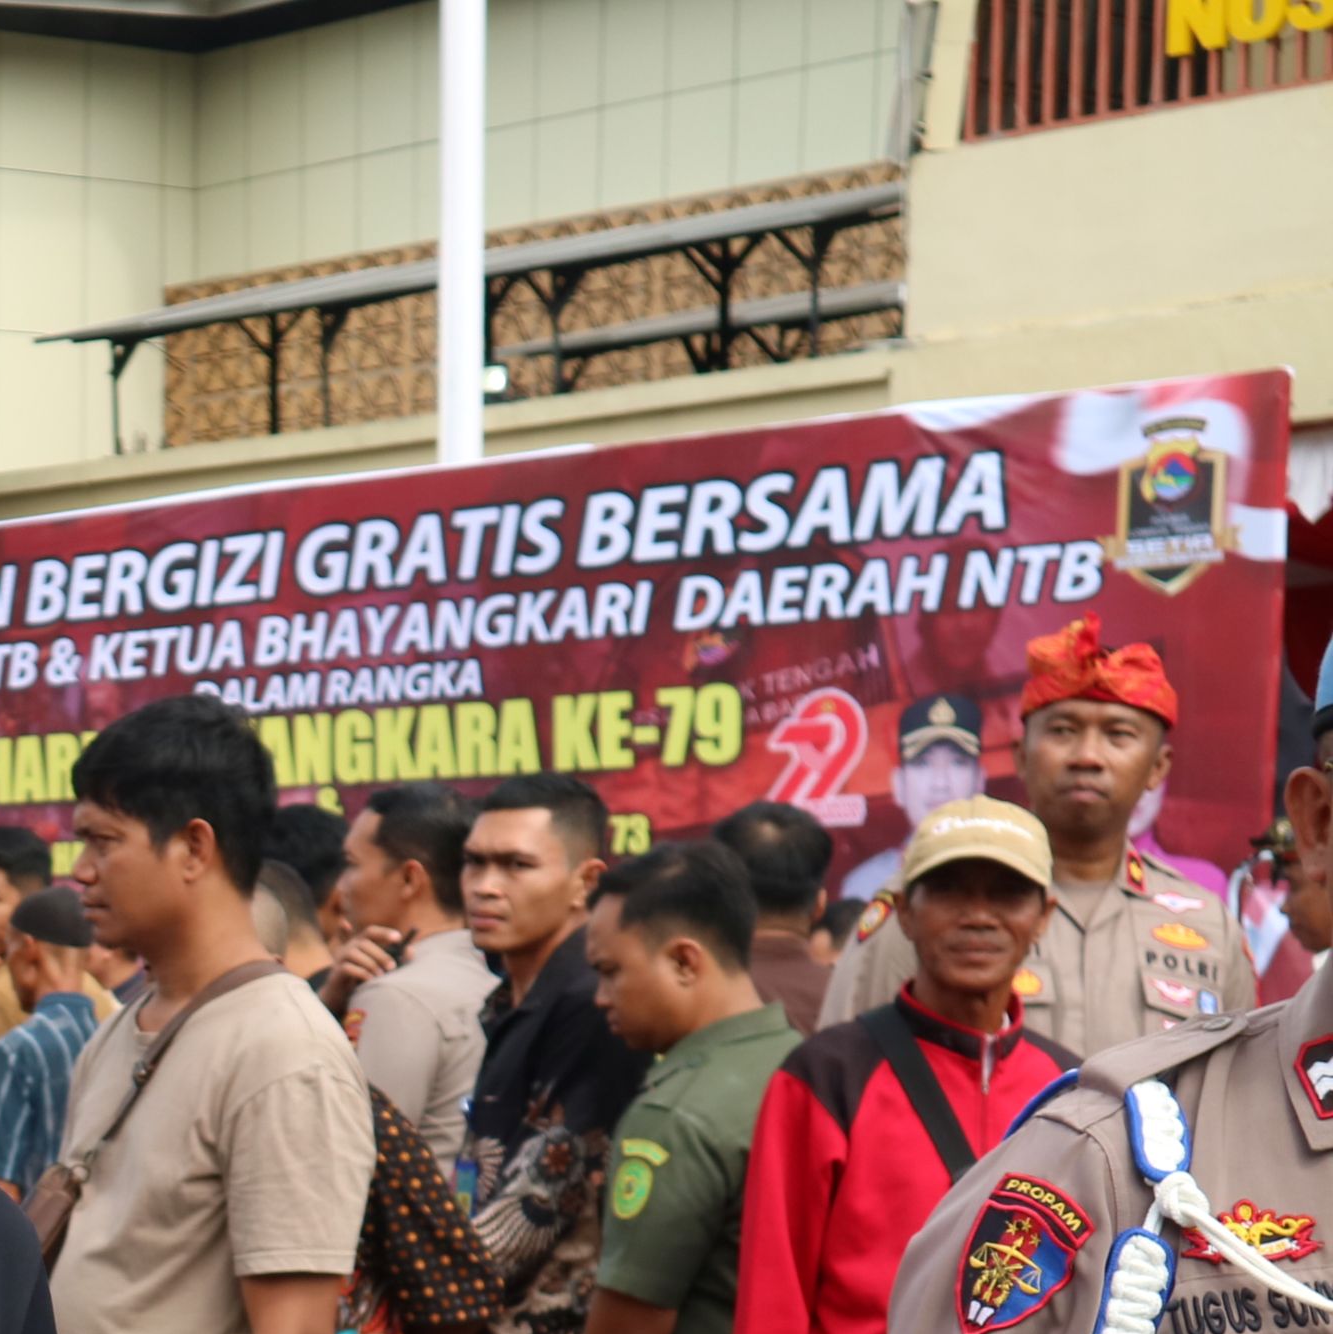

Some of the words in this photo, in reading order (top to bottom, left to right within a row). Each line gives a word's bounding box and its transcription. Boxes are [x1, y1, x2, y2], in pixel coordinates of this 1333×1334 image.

[24, 530, 284, 627] BERGIZI
[294, 498, 564, 597] GRATIS
[576, 450, 1009, 569] BERSAMA
[43, 637, 82, 686] &
[87, 620, 245, 682] KETUA
[253, 581, 652, 668] BHAYANGKARI
[672, 555, 946, 632] DAERAH
[957, 540, 1104, 610] NTB
[324, 658, 483, 706] RANGKA
[251, 698, 542, 788] ANGKARA
[552, 681, 743, 774] KE-79
[1145, 950, 1219, 983] POLRI
[1004, 1178, 1082, 1232] PROPAM
[1267, 1280, 1333, 1330] SUN
